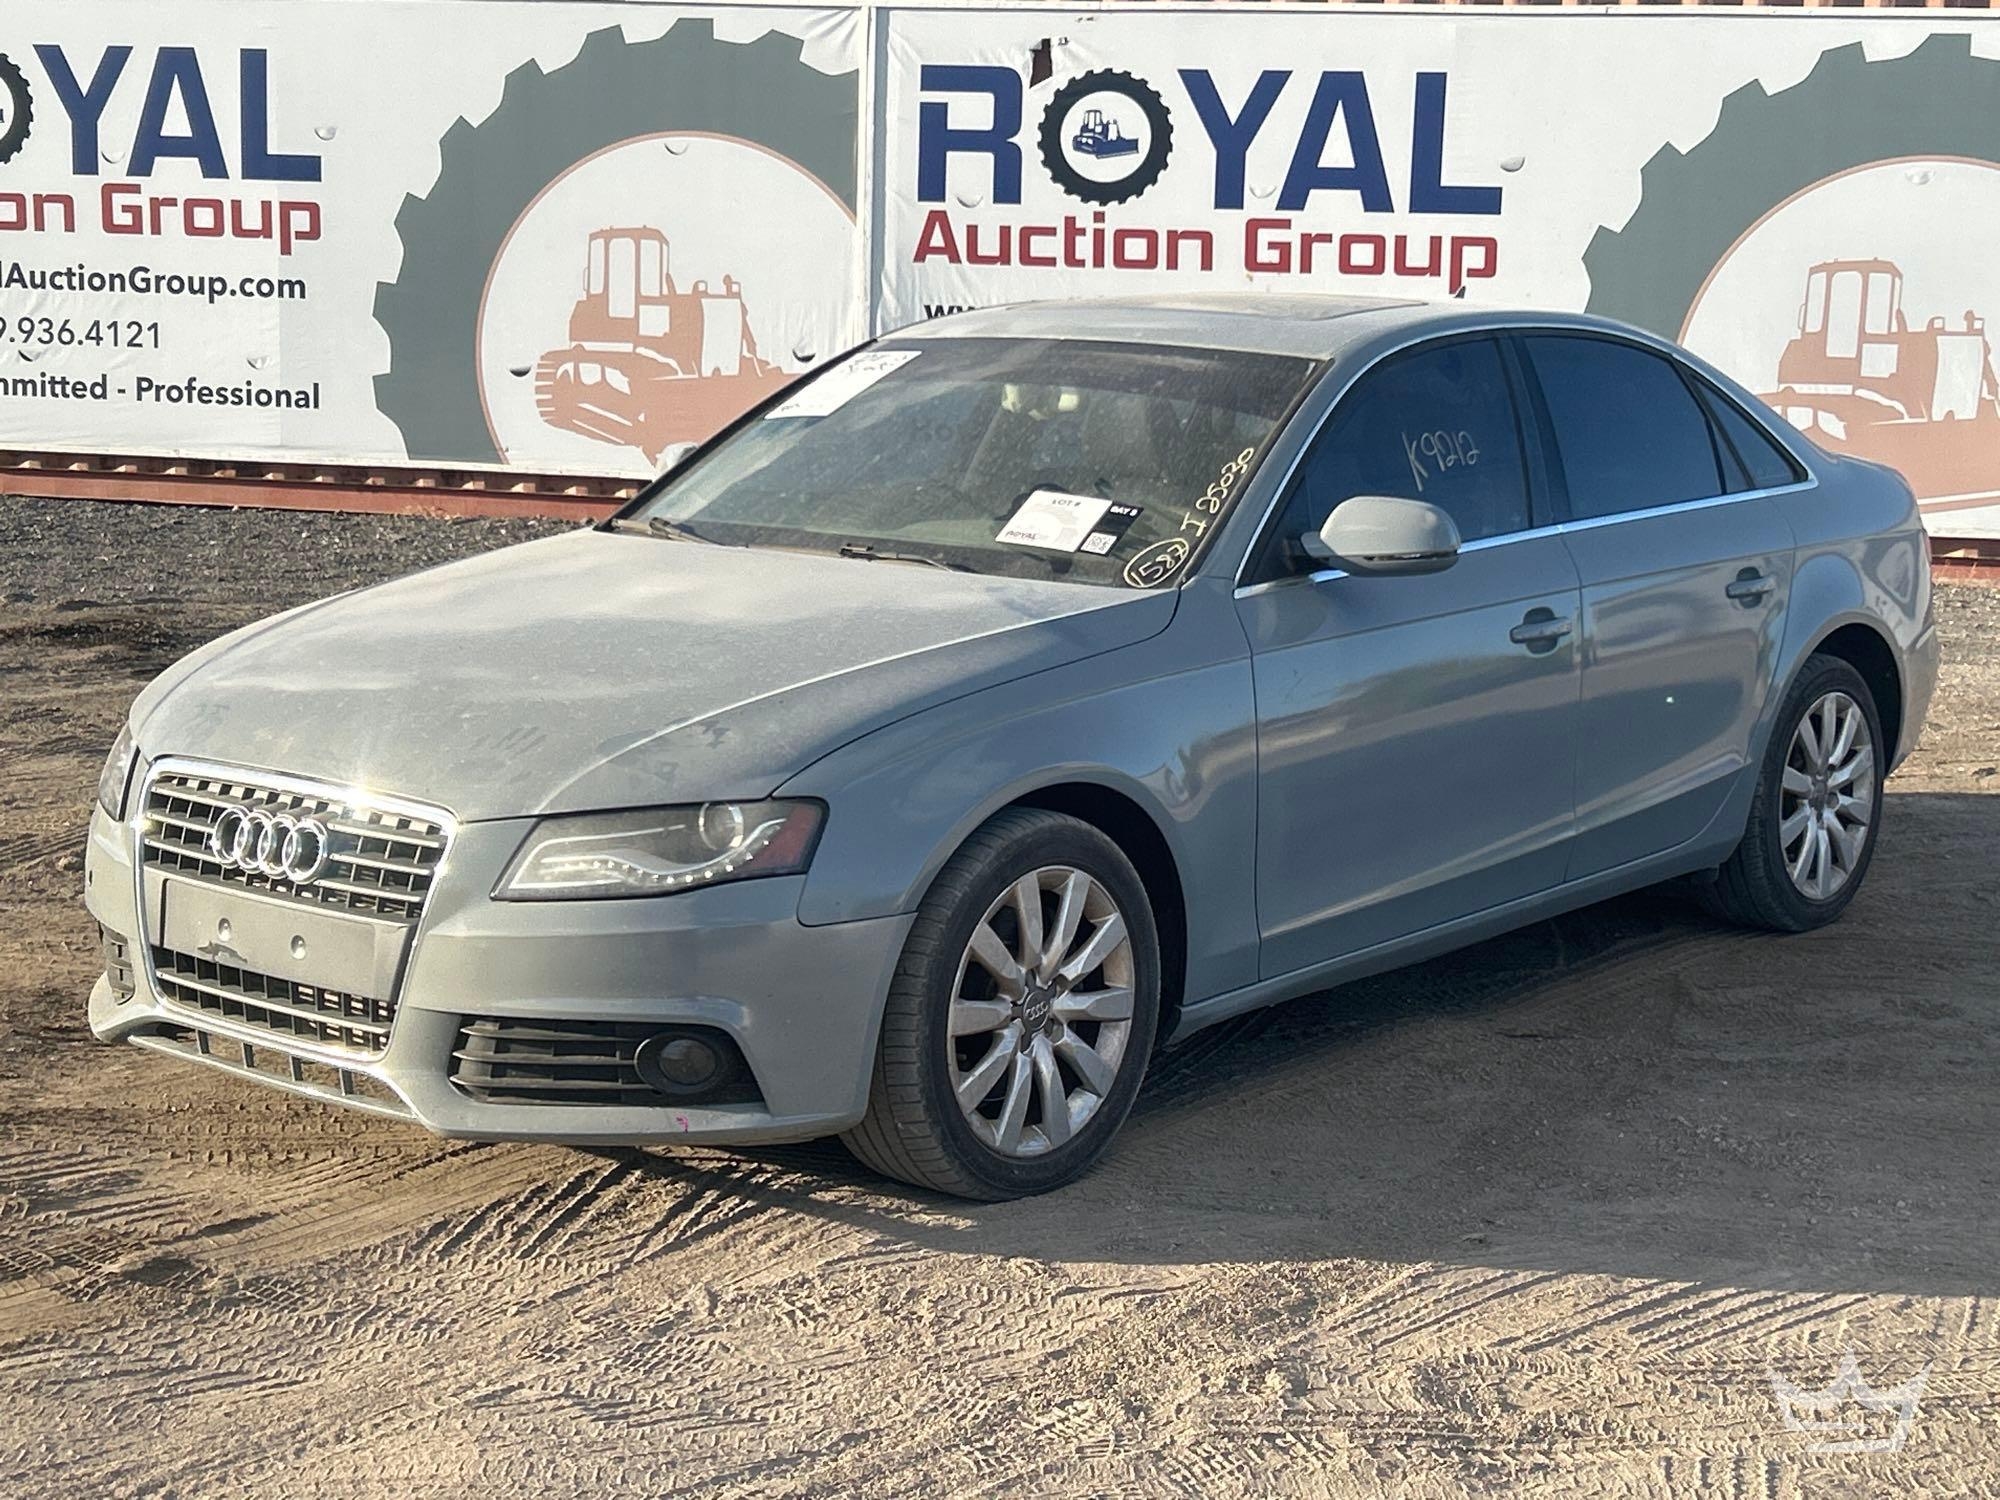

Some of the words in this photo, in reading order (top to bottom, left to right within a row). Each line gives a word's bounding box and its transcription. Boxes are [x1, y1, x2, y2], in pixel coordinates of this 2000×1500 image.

[0, 44, 322, 182] YAL
[917, 64, 1503, 214] ROYAL
[101, 183, 322, 256] Group
[913, 209, 1213, 271] Auction
[1243, 217, 1498, 294] Group
[136, 376, 320, 409] Professional
